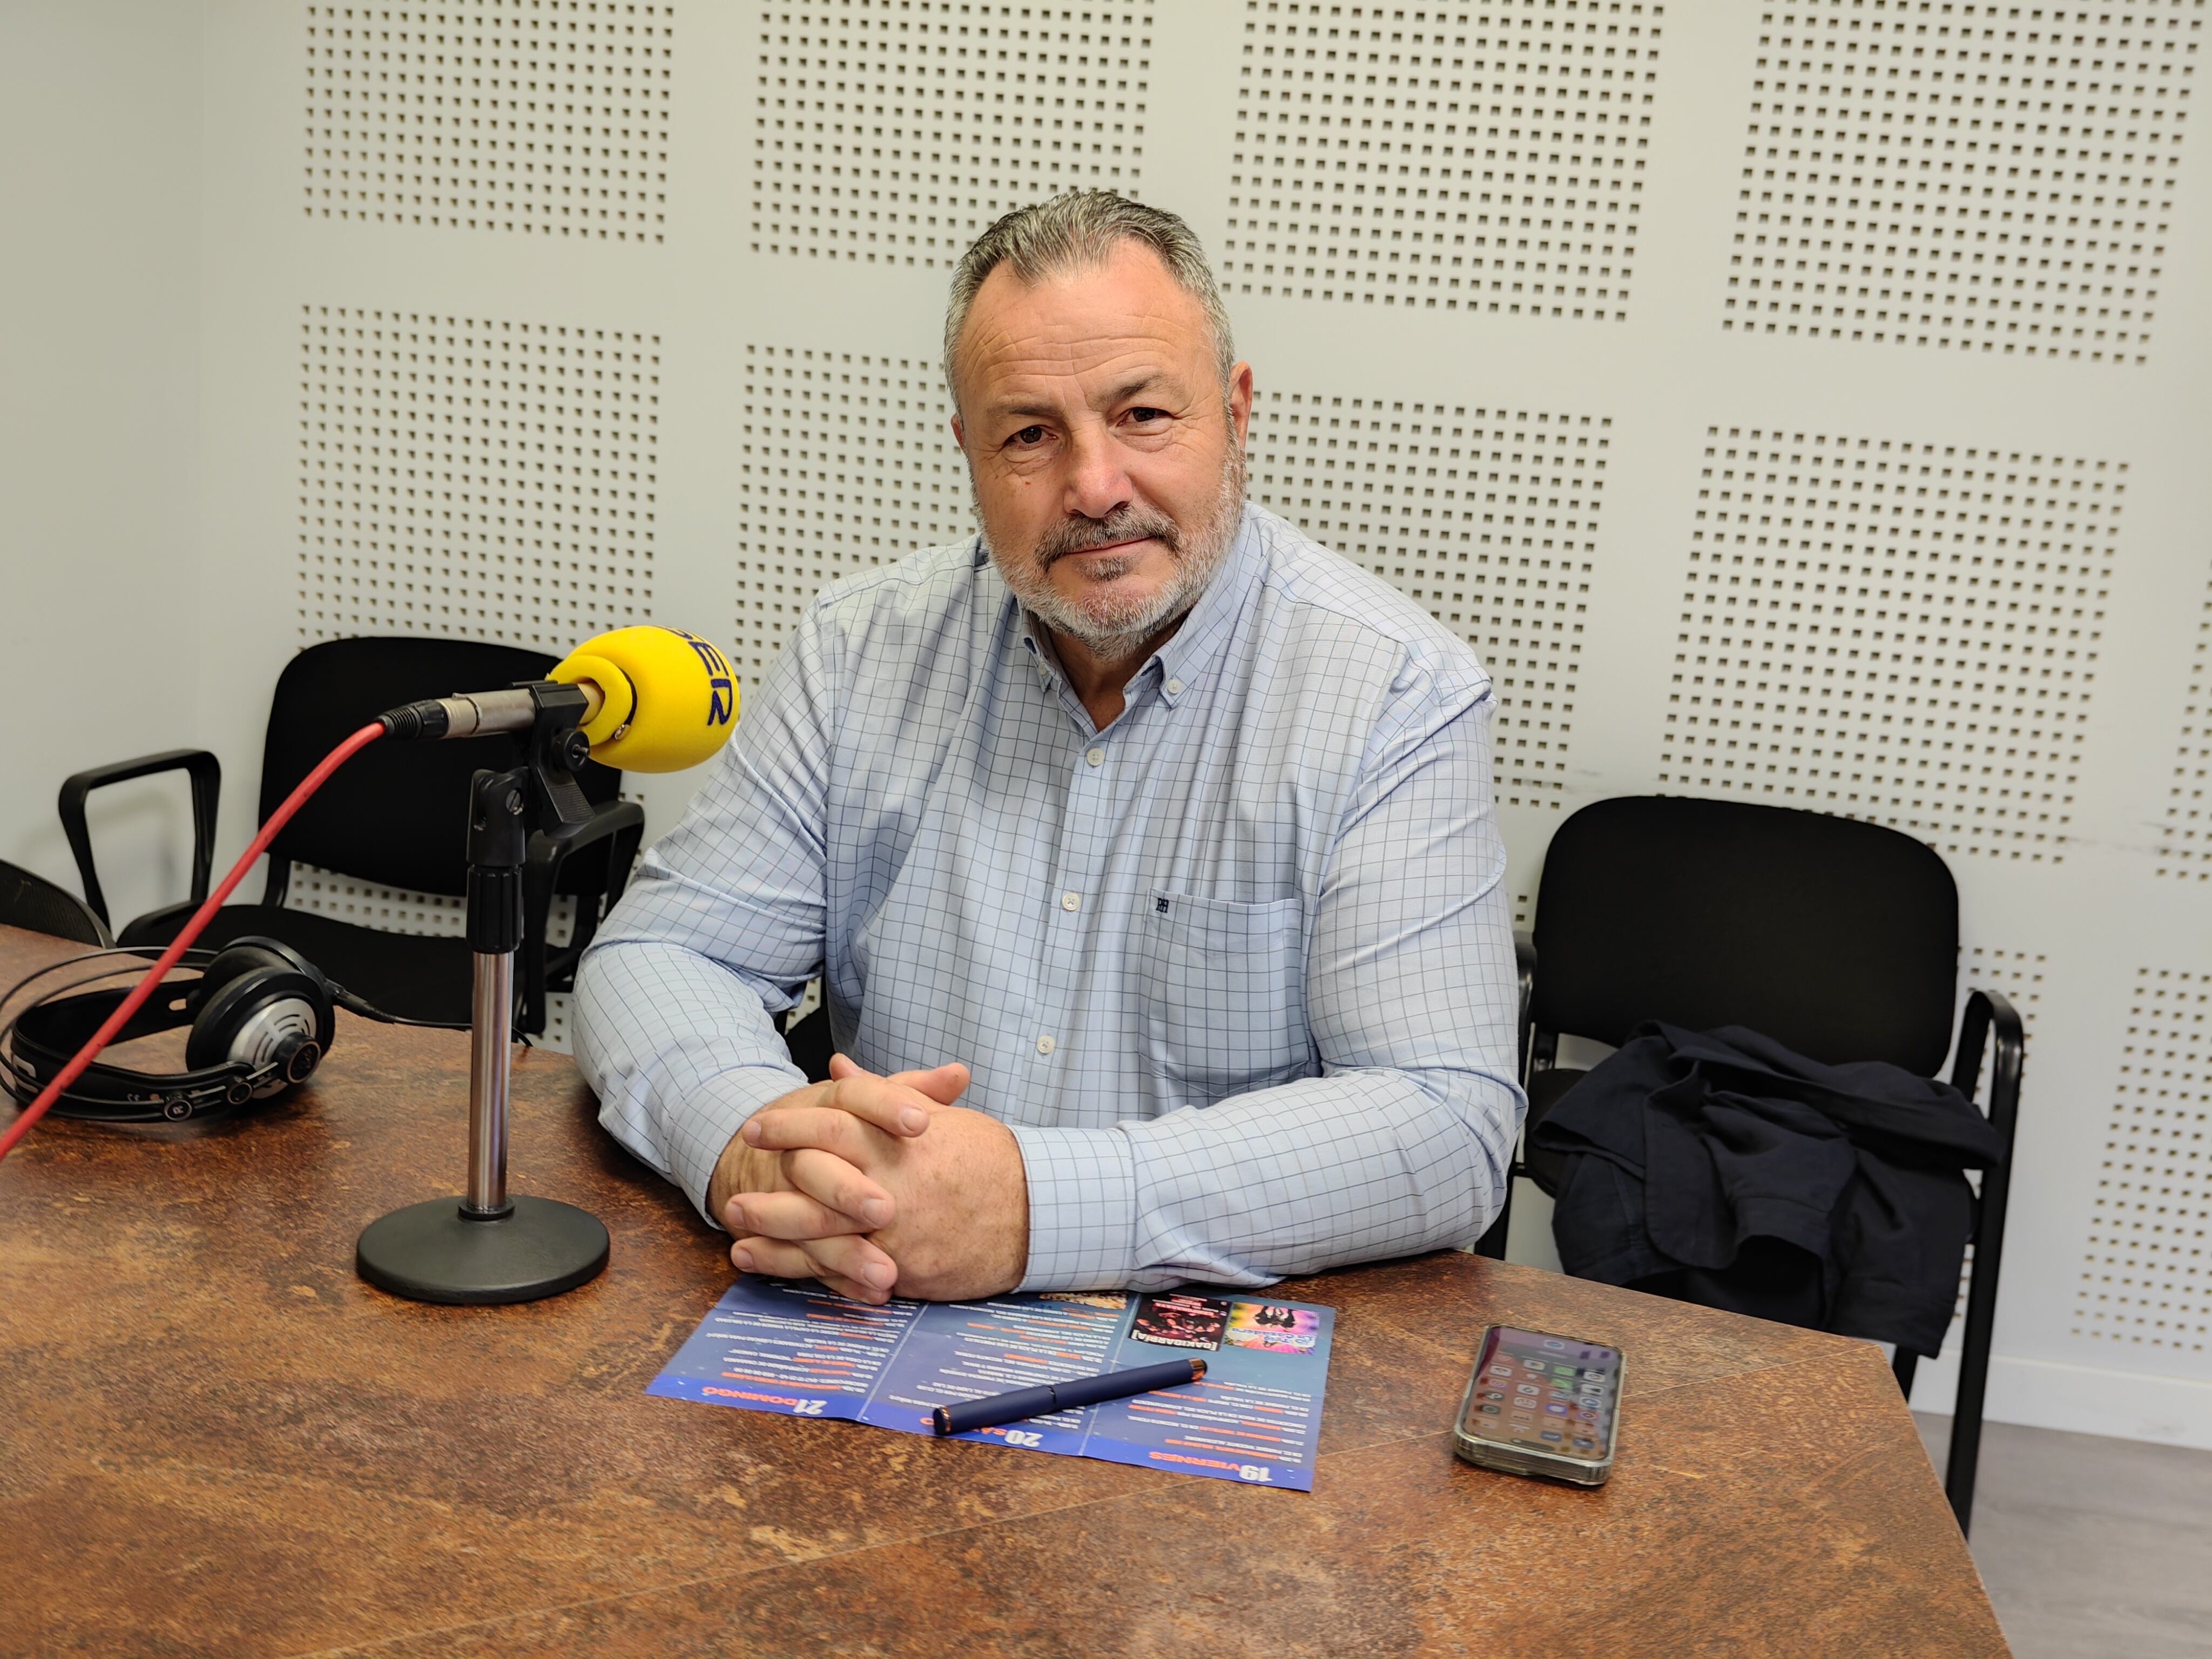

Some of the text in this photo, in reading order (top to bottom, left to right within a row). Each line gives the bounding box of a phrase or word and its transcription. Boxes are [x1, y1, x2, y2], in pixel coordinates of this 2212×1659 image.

[702, 1386, 827, 1415] 21 DOMINGO
[1004, 1429, 1043, 1447] 20
[1149, 1451, 1273, 1482] 19 VIERNES
